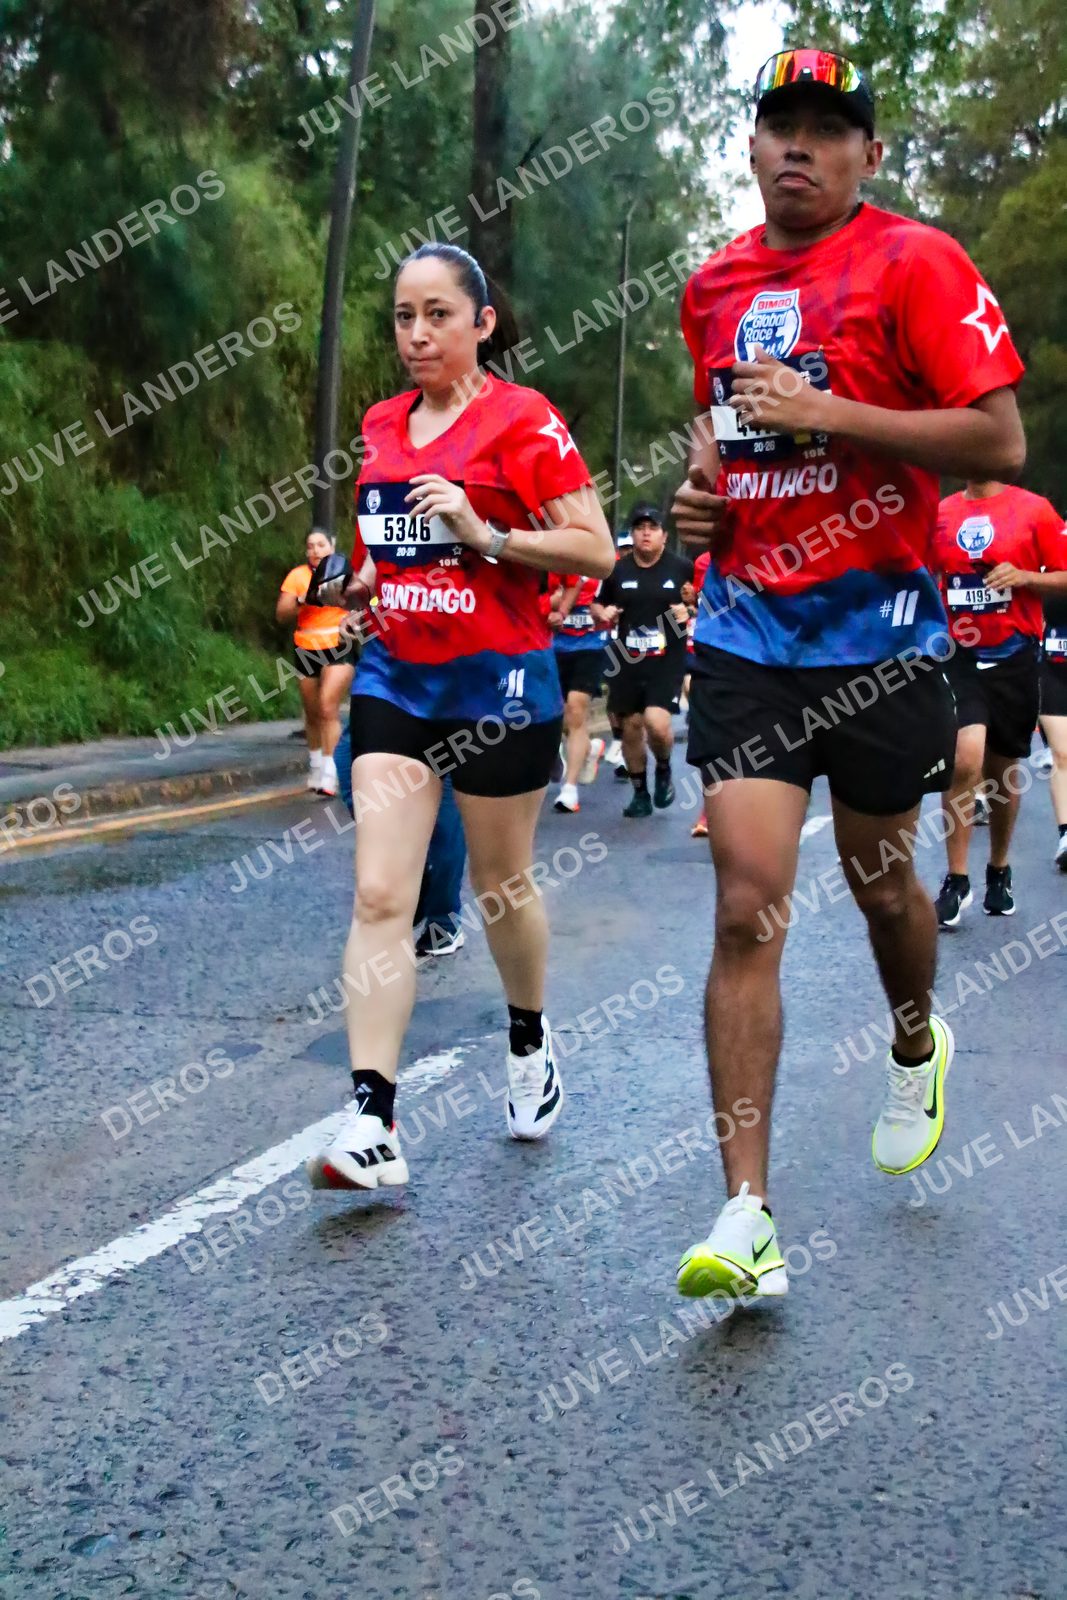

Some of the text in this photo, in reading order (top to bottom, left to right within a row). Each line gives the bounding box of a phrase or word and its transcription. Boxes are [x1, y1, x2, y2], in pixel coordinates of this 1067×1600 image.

[757, 297, 792, 310] BIMBO
[752, 313, 787, 329] Global
[744, 328, 774, 342] Race
[804, 447, 825, 458] 10K
[384, 517, 431, 541] 5346
[439, 559, 459, 567] 10K
[381, 582, 476, 614] SANTIAGO
[965, 590, 992, 602] 4195
